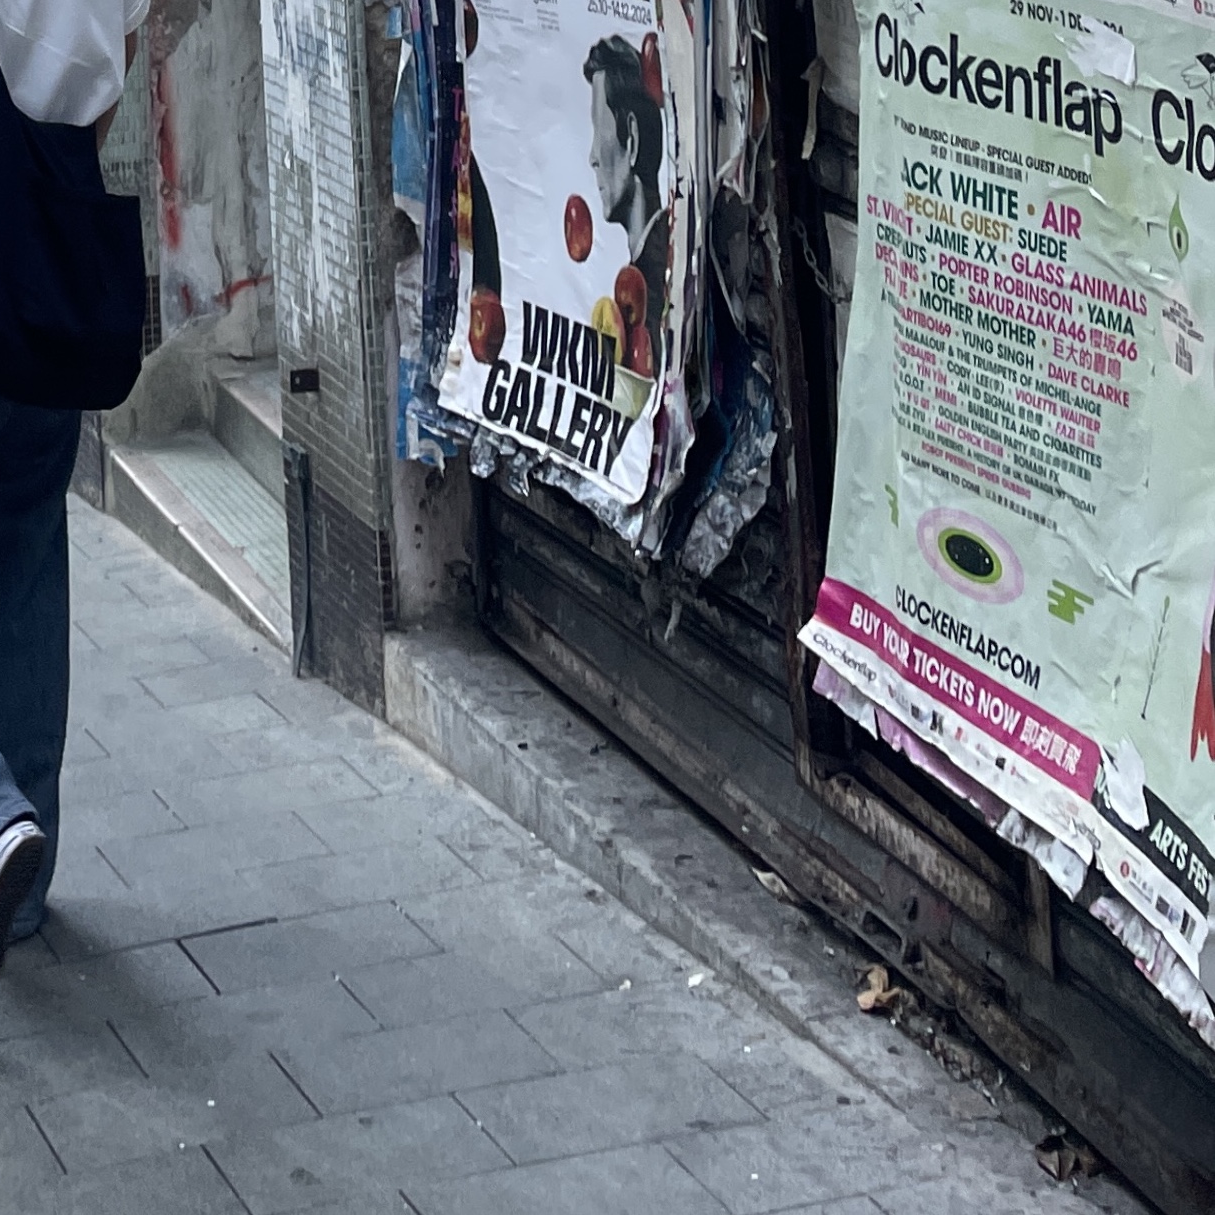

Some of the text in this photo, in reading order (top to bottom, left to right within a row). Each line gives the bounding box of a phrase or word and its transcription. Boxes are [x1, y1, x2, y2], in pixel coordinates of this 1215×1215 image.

[1069, 11, 1091, 34] DE
[875, 12, 1123, 157] Clockenflap
[919, 123, 948, 144] MUSIC
[950, 131, 980, 152] LINEUP
[987, 140, 1023, 166] SPECIAL
[1025, 156, 1055, 178] GUEST
[901, 156, 943, 197] ACK
[950, 170, 1018, 221] WHITE
[1042, 199, 1082, 240] AIR
[904, 191, 1067, 263] PECIAL GUEST: SUEDE
[925, 224, 969, 256] JAMIE
[974, 239, 998, 266] XX
[1012, 252, 1065, 288] GLASS
[1070, 272, 1147, 316] ANIMALS
[940, 252, 989, 287] PORTER
[994, 272, 1073, 316] ROBINSON
[1087, 302, 1135, 337] YAMA
[920, 289, 973, 327] MOTHER
[977, 310, 1036, 349] MOTHER
[931, 271, 955, 297] TOE
[968, 284, 1086, 343] SAKURAZAKA46
[522, 300, 617, 404] WKM
[957, 347, 970, 364] THE
[973, 354, 1017, 383] TRUMPETS
[1020, 374, 1033, 387] OF
[1035, 379, 1102, 418] MICHEL-ANGE
[962, 329, 994, 354] YUNG
[997, 343, 1034, 371] SINGH
[1048, 362, 1078, 388] DAVE
[1081, 376, 1130, 408] CLARKE
[482, 359, 634, 477] GALLERY
[938, 405, 969, 427] GOLDEN
[968, 401, 998, 425] BUBBLE
[1001, 415, 1016, 433] TEA
[1019, 424, 1040, 441] AND
[1043, 433, 1102, 469] CIGARETTES
[1015, 388, 1057, 416] VIOLETTE
[1060, 405, 1101, 435] WAUTIER
[850, 601, 881, 642] BUY
[882, 621, 909, 669] YOUR
[912, 646, 975, 708] TICKETS
[978, 693, 1021, 735] NOW
[895, 584, 1041, 690] CLOCKENFLAP.COM
[1149, 819, 1188, 871] ARTS
